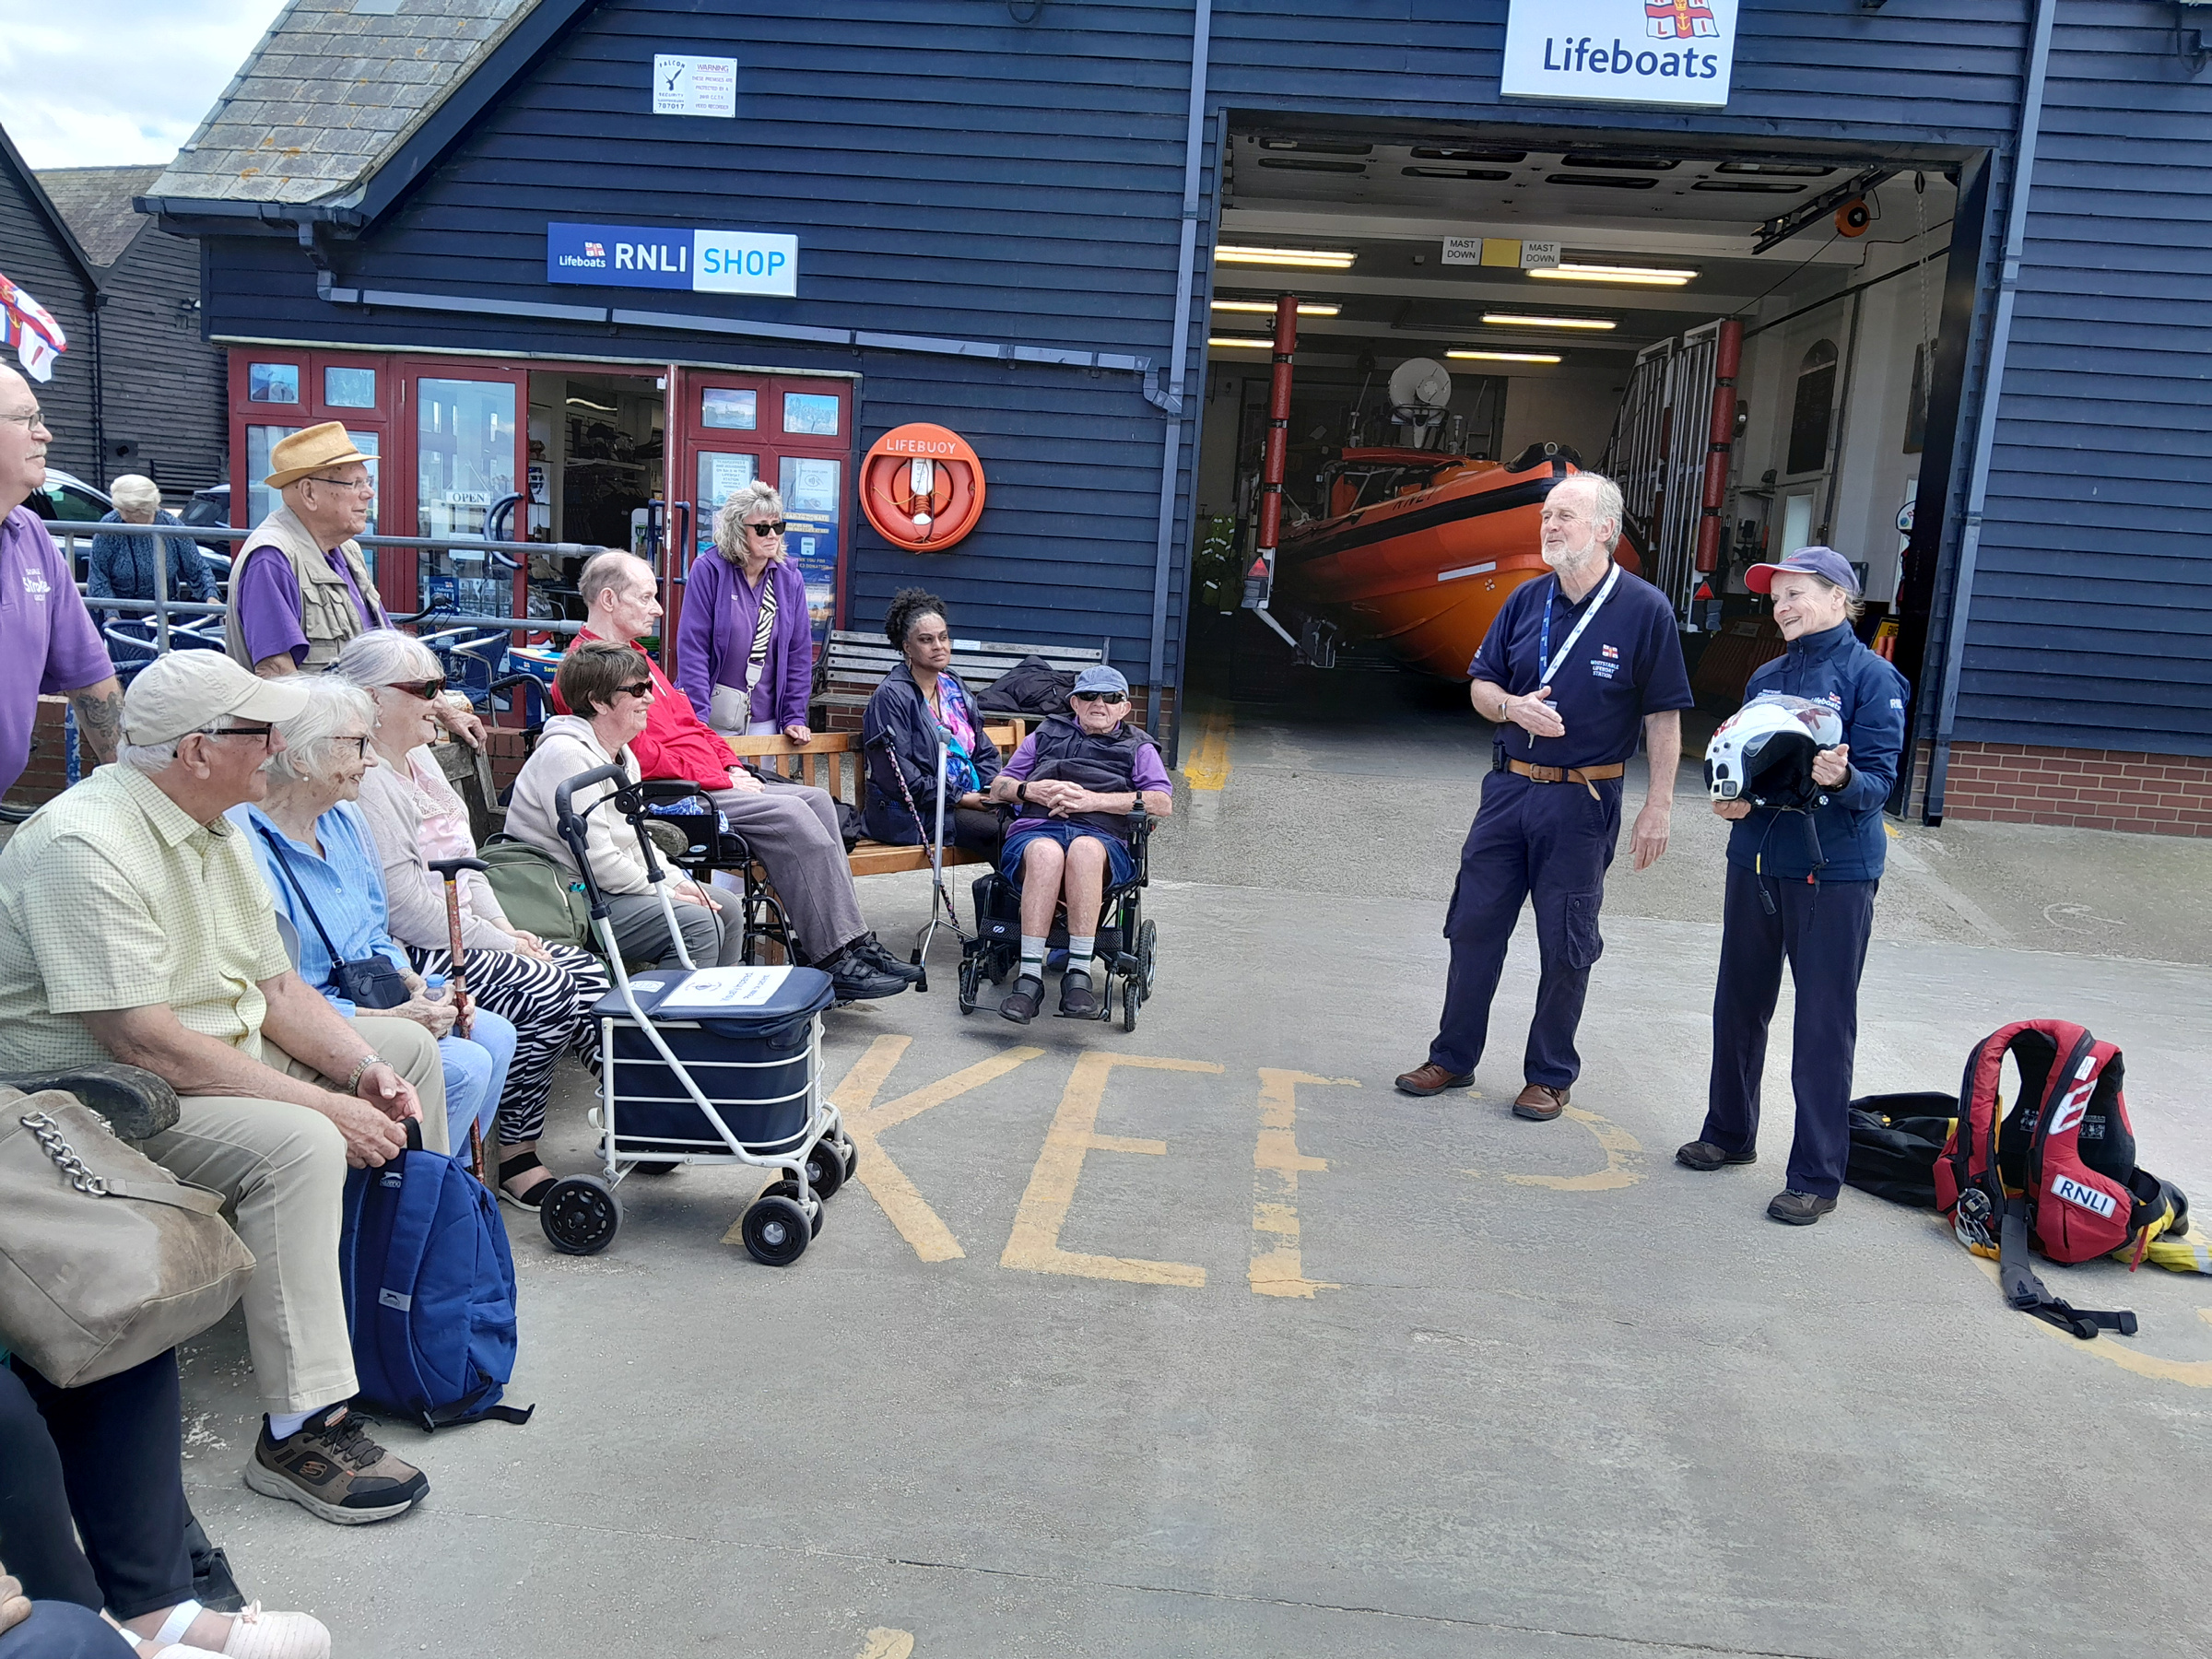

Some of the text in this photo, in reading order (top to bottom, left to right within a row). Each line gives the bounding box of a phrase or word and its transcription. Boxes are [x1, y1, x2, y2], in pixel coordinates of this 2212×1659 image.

[1543, 37, 1718, 79] Lifeboats
[659, 60, 686, 69] FALCON
[1450, 240, 1476, 249] MAST
[1528, 243, 1555, 253] MAST
[559, 242, 786, 276] Lifeboats RNLI SHOP
[1447, 250, 1476, 259] DOWN
[1525, 253, 1555, 263] DOWN
[886, 438, 957, 454] LIFEBUOY
[453, 492, 485, 503] OPEN
[22, 576, 51, 593] Stroke
[1593, 665, 1615, 674] LIFEBOAT
[1593, 671, 1613, 679] STATION
[2059, 1179, 2109, 1213] RNLI
